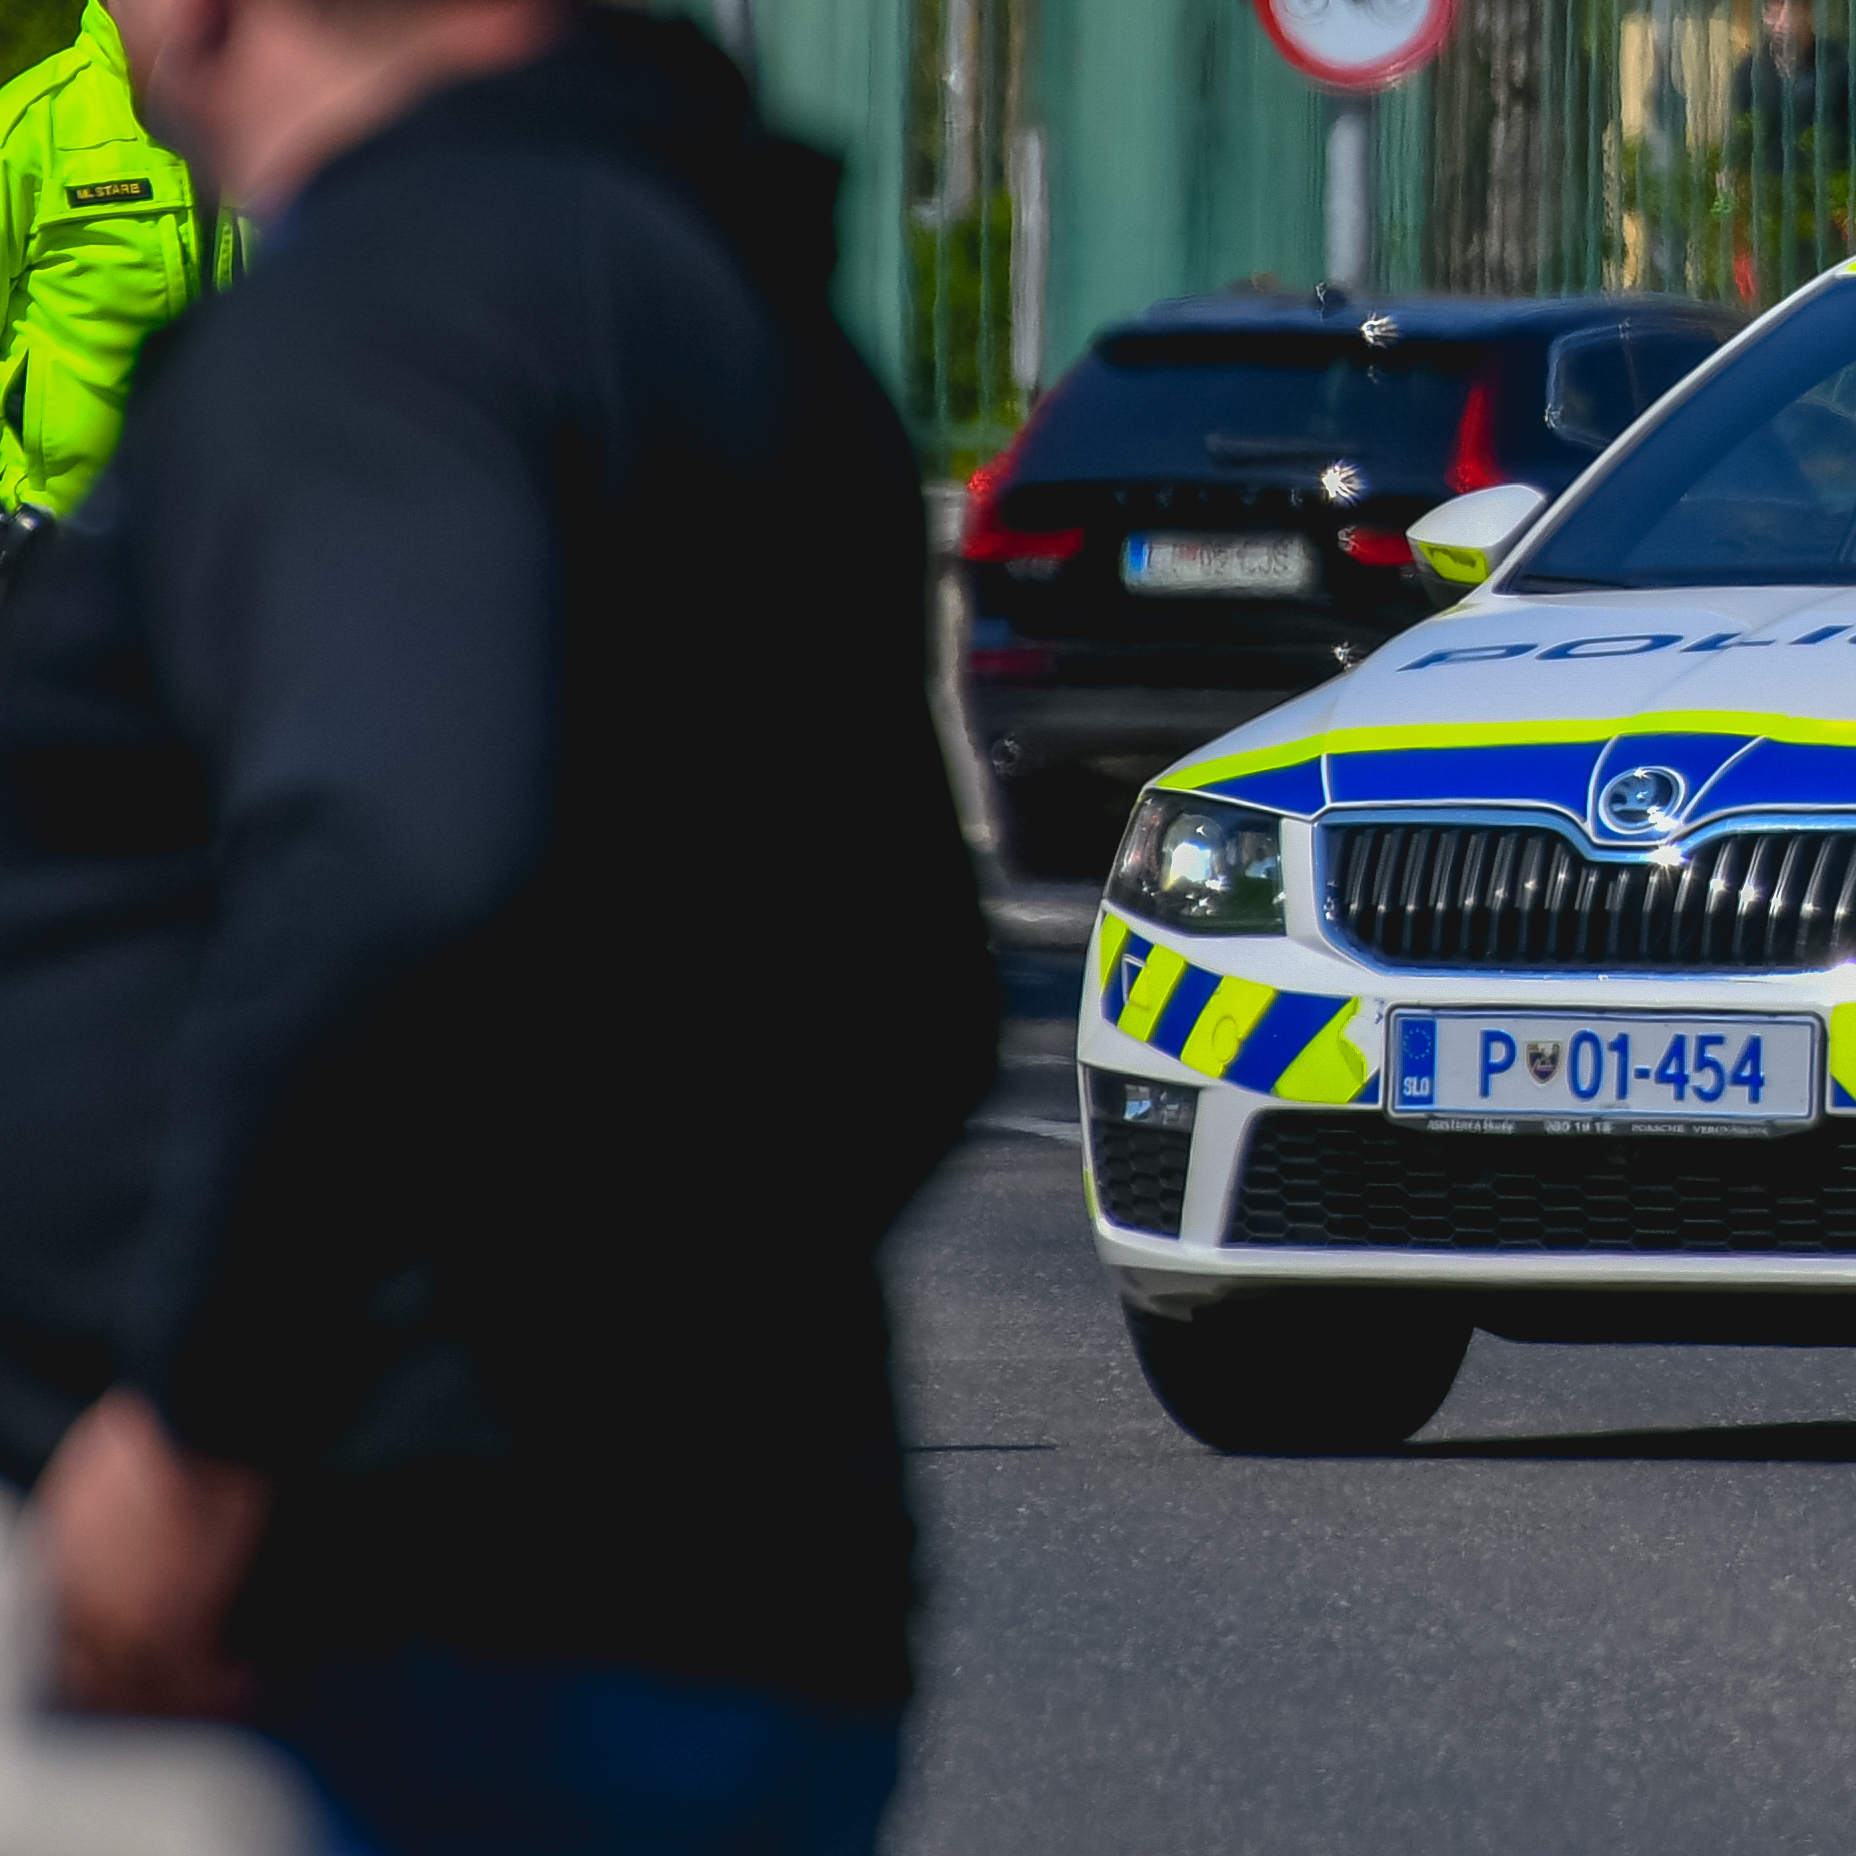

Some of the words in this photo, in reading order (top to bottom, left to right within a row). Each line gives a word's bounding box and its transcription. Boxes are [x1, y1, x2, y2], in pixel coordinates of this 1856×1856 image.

[1403, 1075, 1431, 1097] SLO
[1477, 1027, 1517, 1099] P
[1565, 1027, 1766, 1104] 01-454
